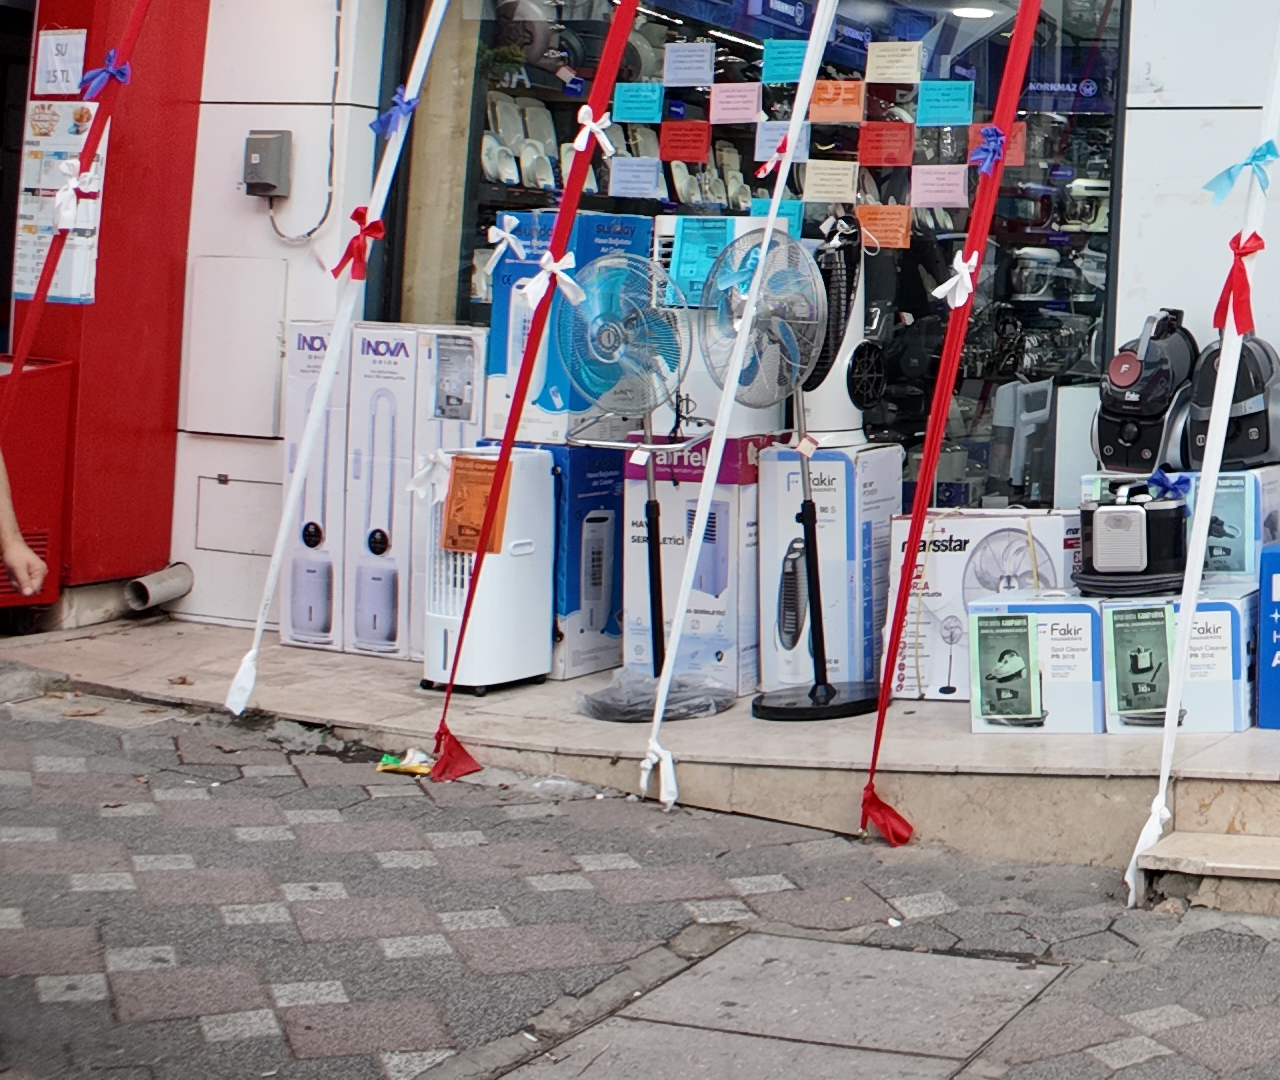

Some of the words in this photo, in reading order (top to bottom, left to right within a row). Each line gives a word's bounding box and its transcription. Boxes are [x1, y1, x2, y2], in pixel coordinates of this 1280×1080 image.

[55, 43, 68, 57] SU
[60, 70, 71, 83] TL
[1029, 82, 1078, 93] KORKMAZ
[361, 336, 410, 358] INOVA
[809, 472, 837, 487] akir
[1050, 622, 1083, 636] Fakir
